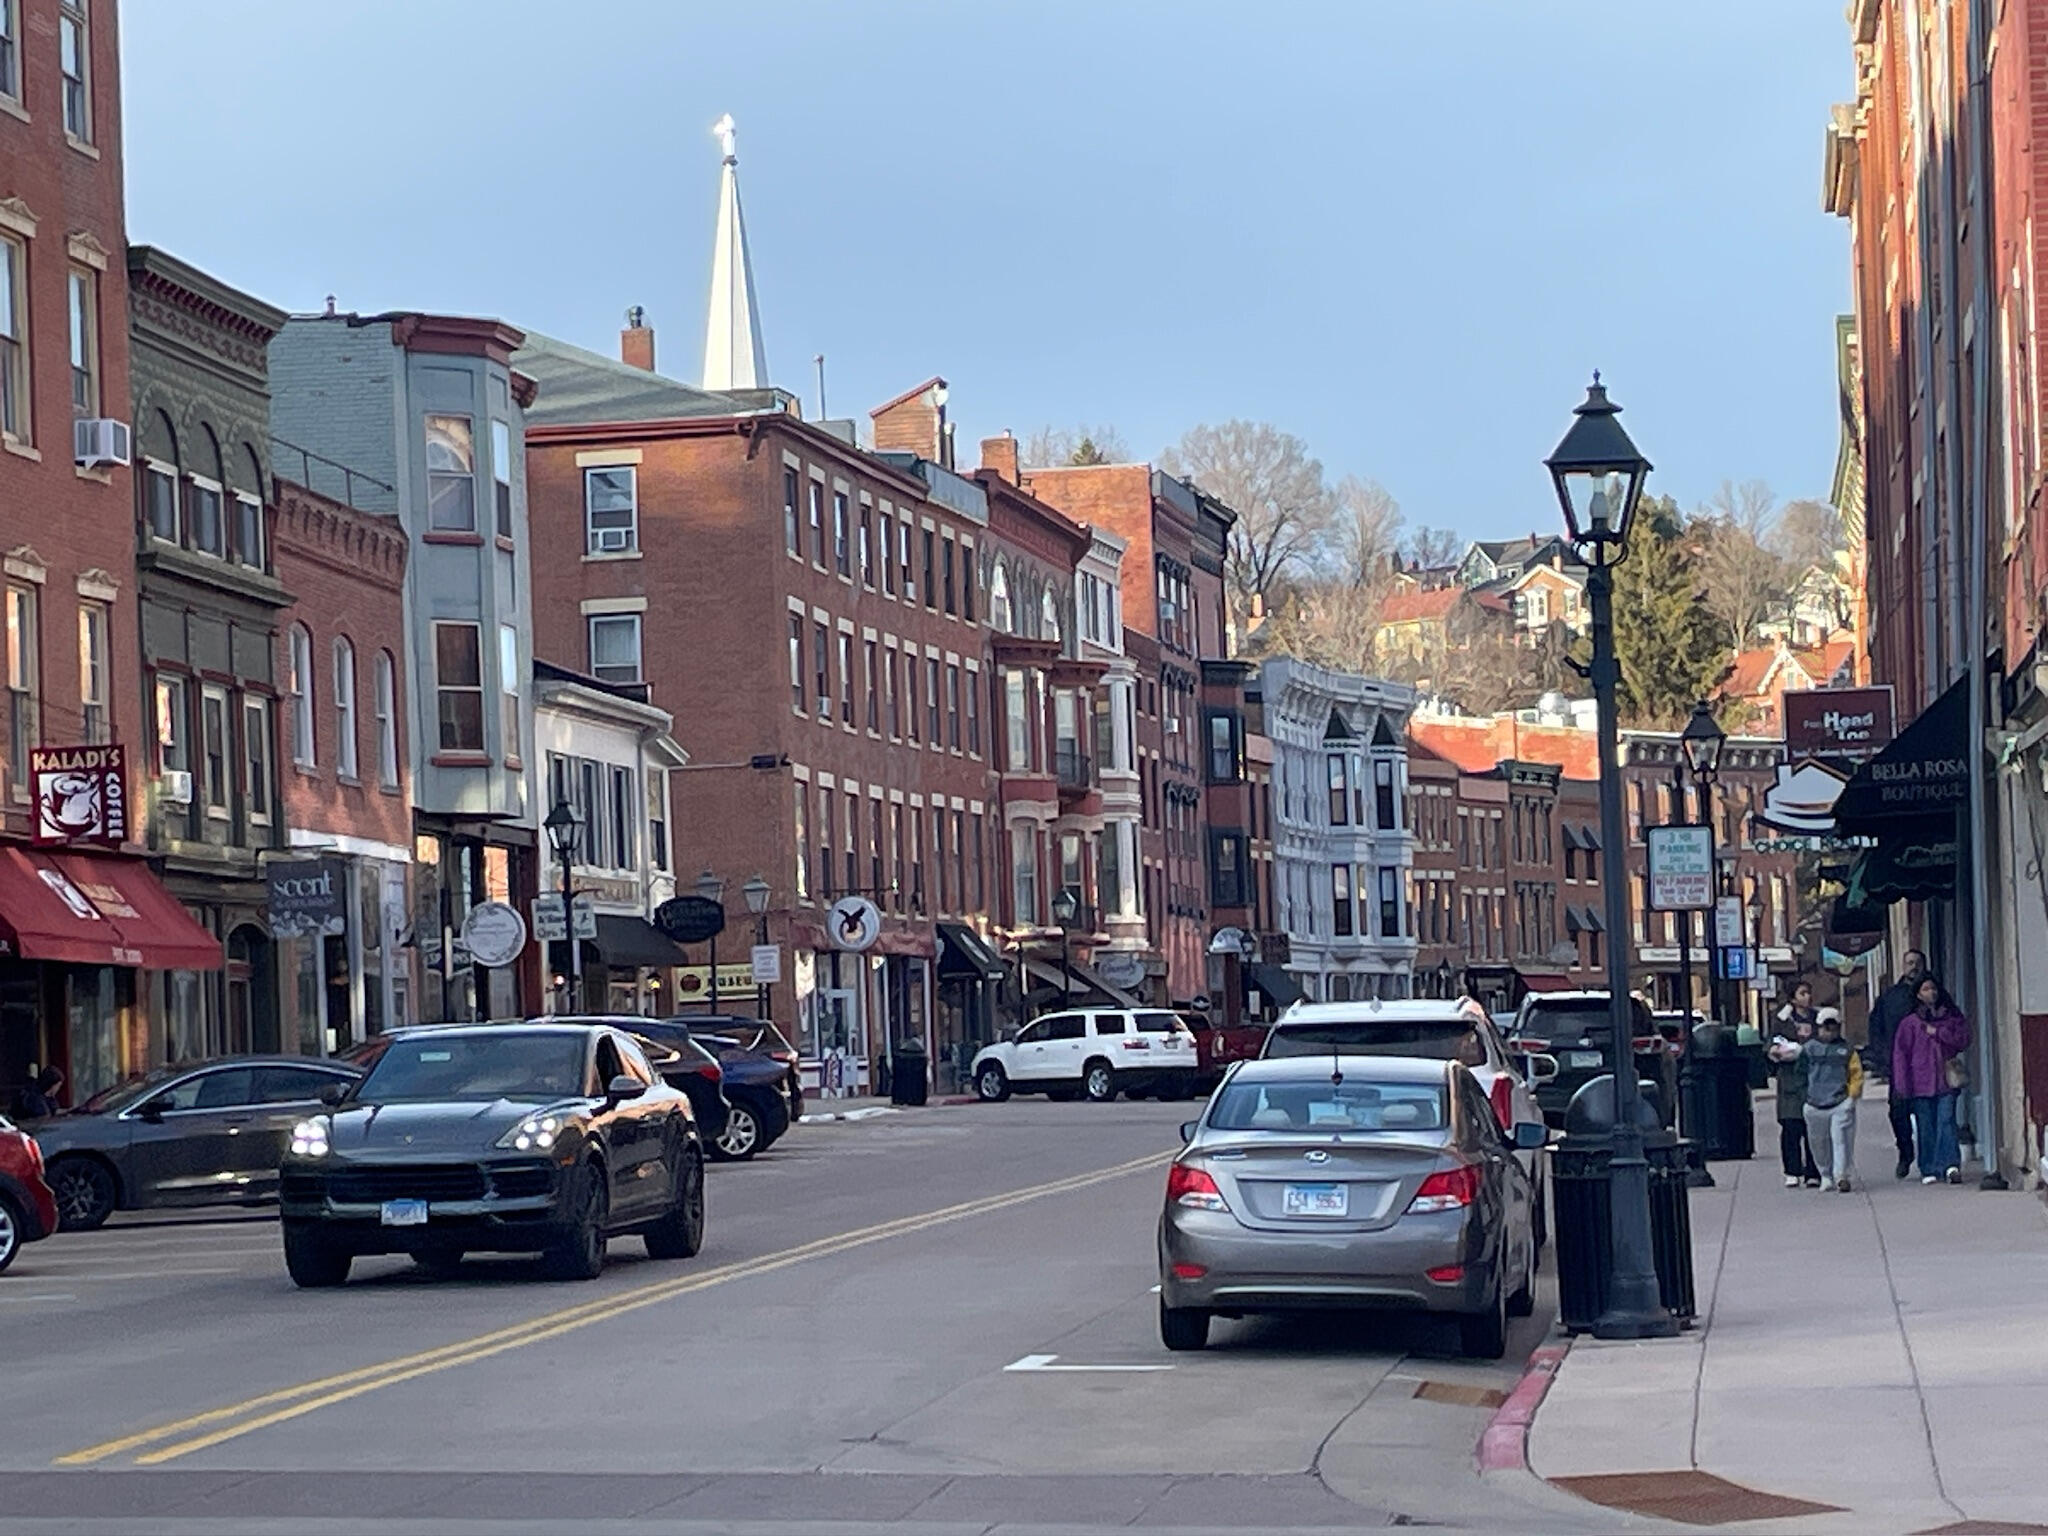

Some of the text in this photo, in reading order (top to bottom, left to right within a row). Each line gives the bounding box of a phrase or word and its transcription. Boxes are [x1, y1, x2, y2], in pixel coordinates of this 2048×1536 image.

[33, 748, 120, 771] KALADI'S
[1872, 758, 1968, 780] BELLA ROSA
[105, 772, 124, 839] COFFEE
